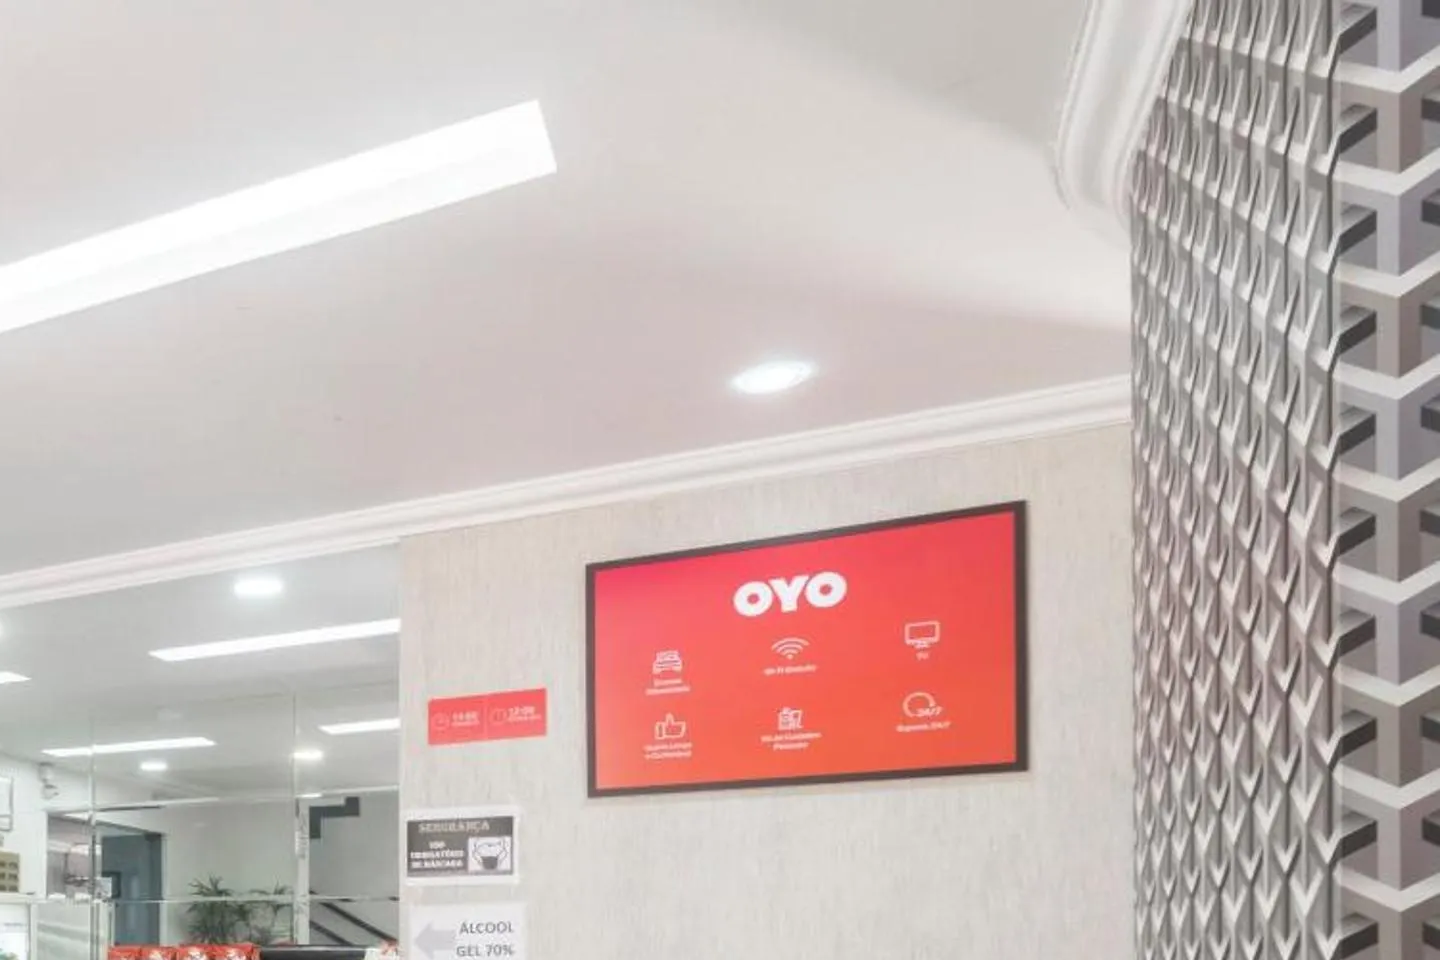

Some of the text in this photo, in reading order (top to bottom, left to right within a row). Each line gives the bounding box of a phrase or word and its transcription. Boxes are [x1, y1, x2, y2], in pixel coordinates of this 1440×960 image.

[733, 571, 848, 617] OYO
[456, 943, 515, 958] GEL 70%
